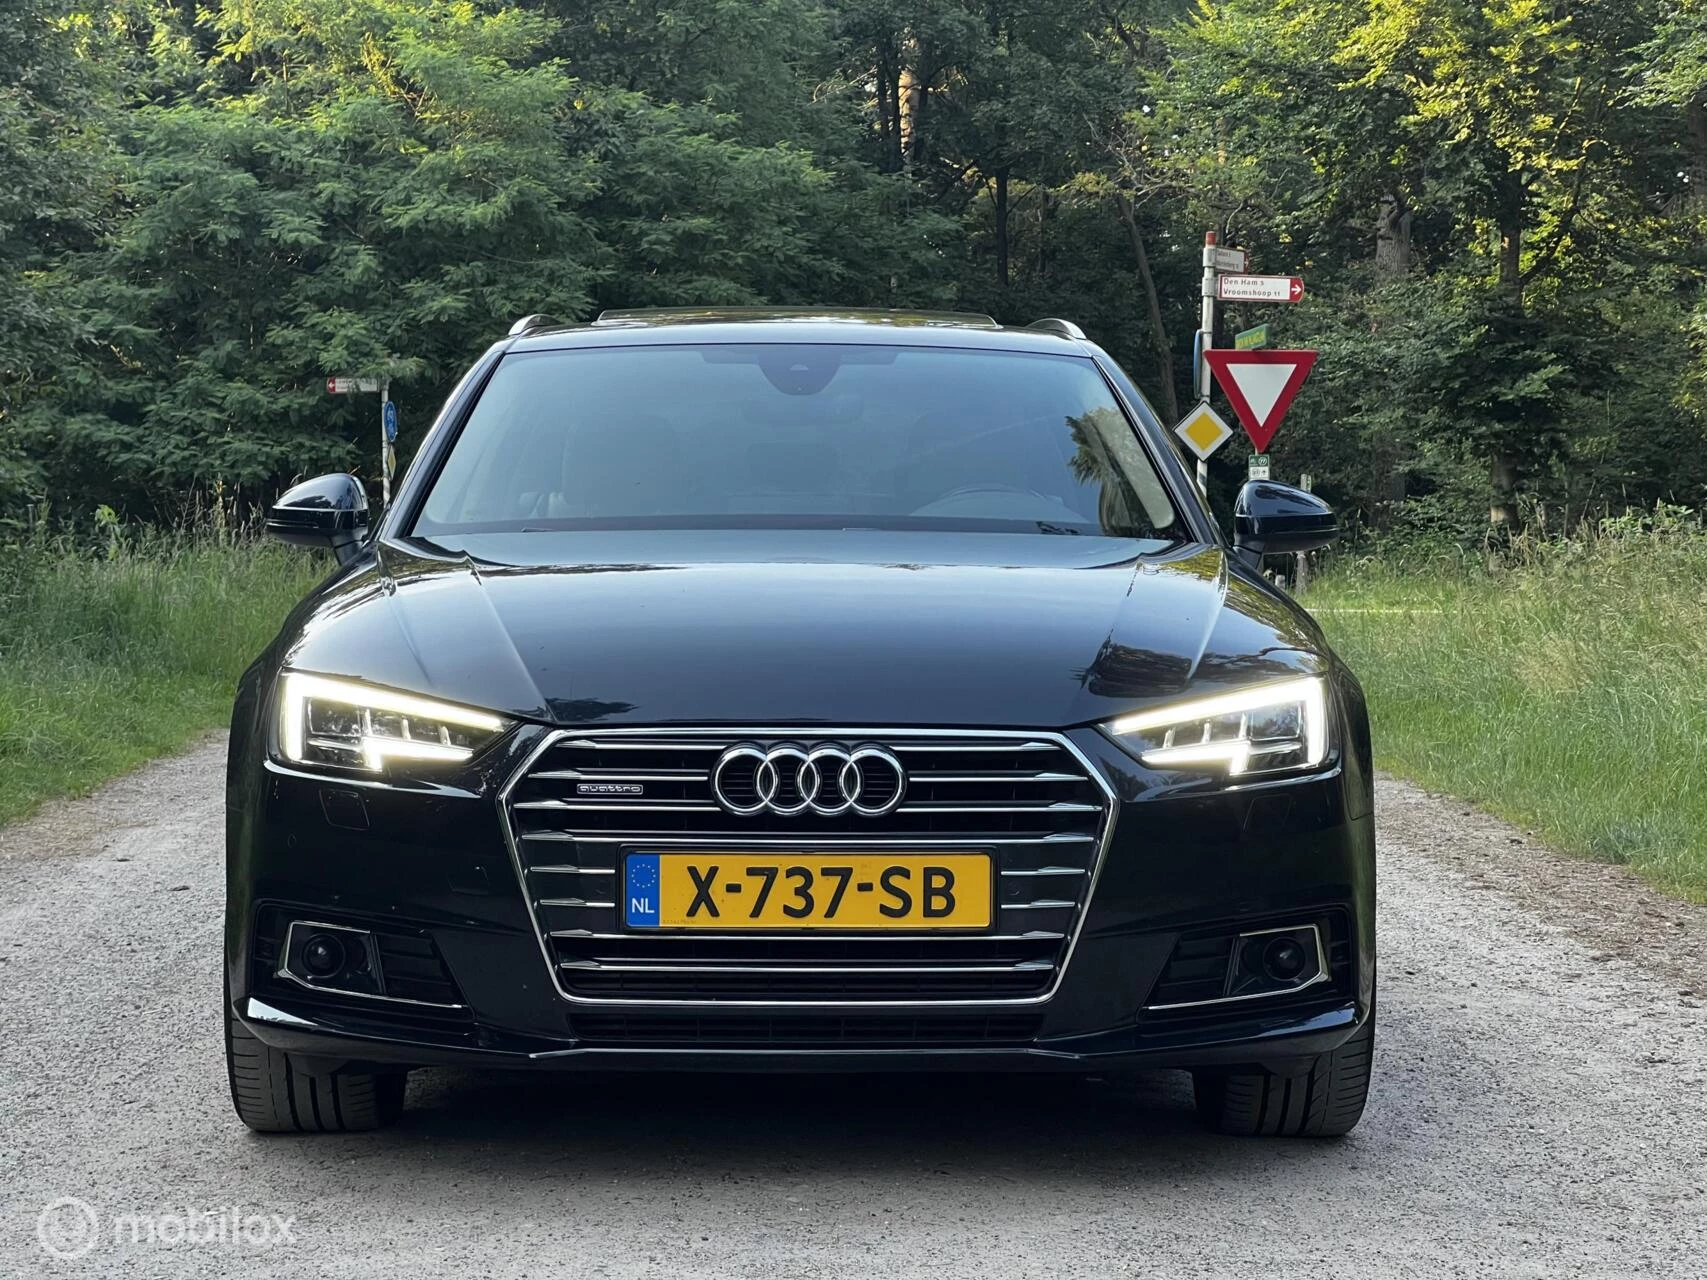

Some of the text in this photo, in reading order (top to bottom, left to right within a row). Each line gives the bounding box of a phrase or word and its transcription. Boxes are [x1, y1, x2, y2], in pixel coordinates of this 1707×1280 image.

[1223, 277, 1239, 285] Den
[1223, 288, 1272, 297] Vroomshoop
[579, 785, 641, 793] quattro
[686, 866, 956, 918] X-737-SB
[631, 897, 655, 913] NL
